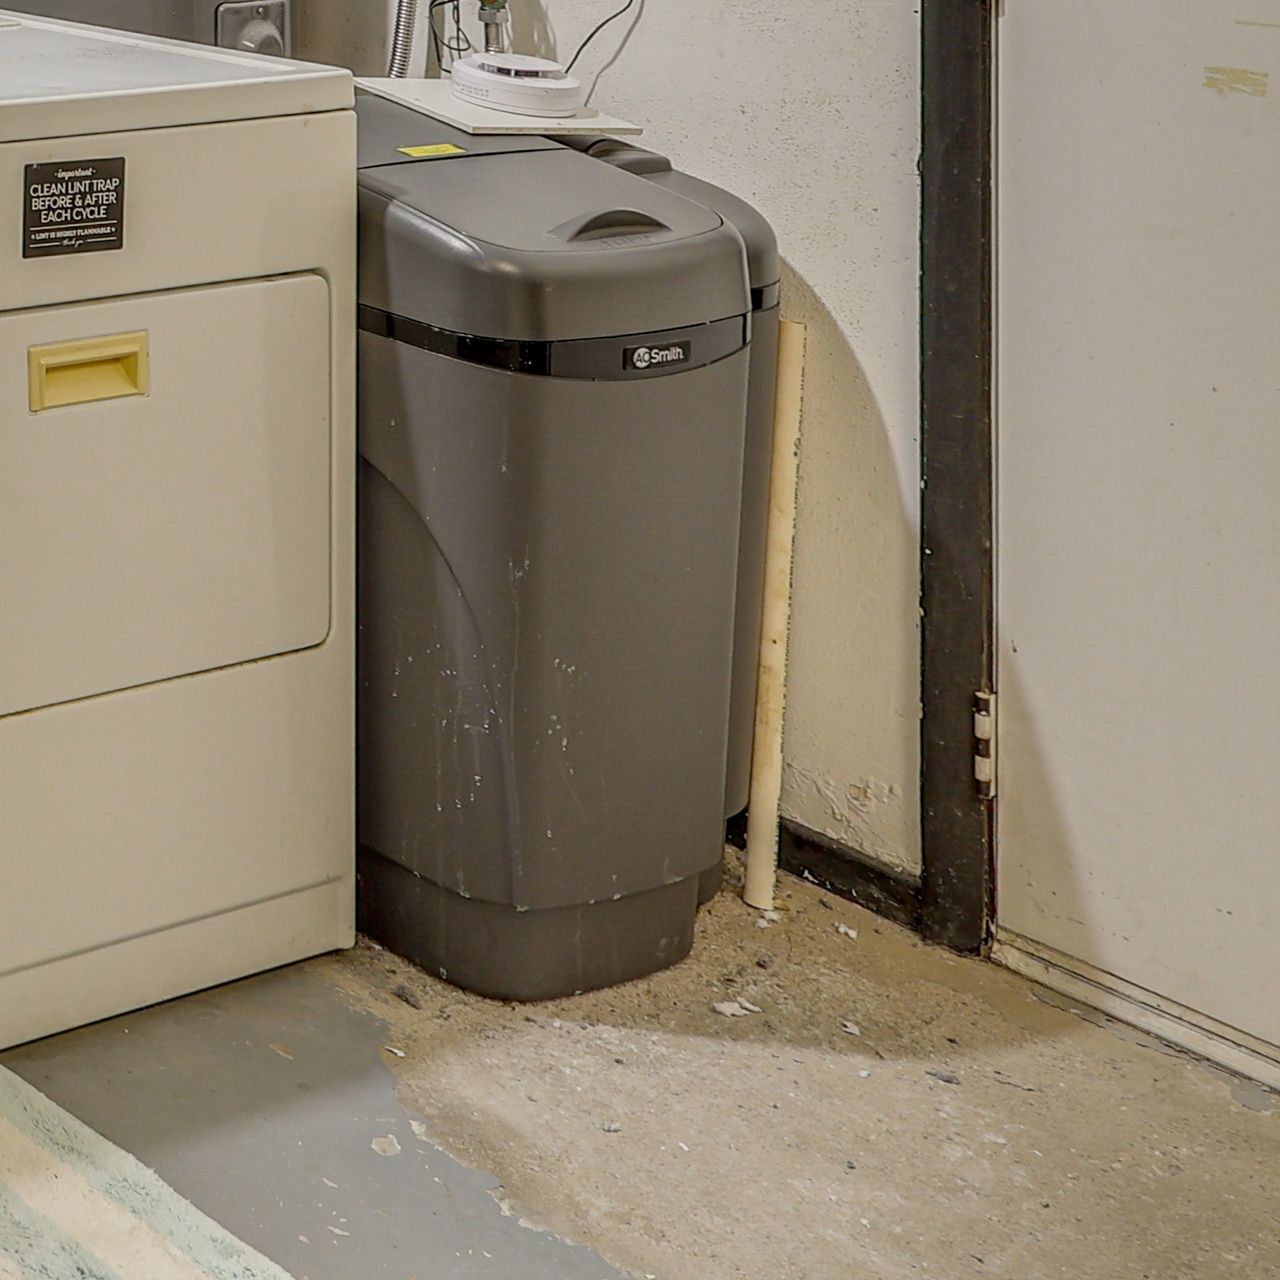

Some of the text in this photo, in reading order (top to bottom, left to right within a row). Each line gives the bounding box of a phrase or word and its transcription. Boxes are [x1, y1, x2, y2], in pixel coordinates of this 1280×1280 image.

[58, 168, 92, 180] important
[30, 178, 119, 197] CLEAN LINT TRAP
[32, 192, 117, 210] BEFORE & AFTER
[41, 206, 107, 223] EACH CYCLE
[36, 232, 49, 240] LINT
[78, 227, 111, 236] FLAMMABLE
[651, 347, 684, 363] Smith
